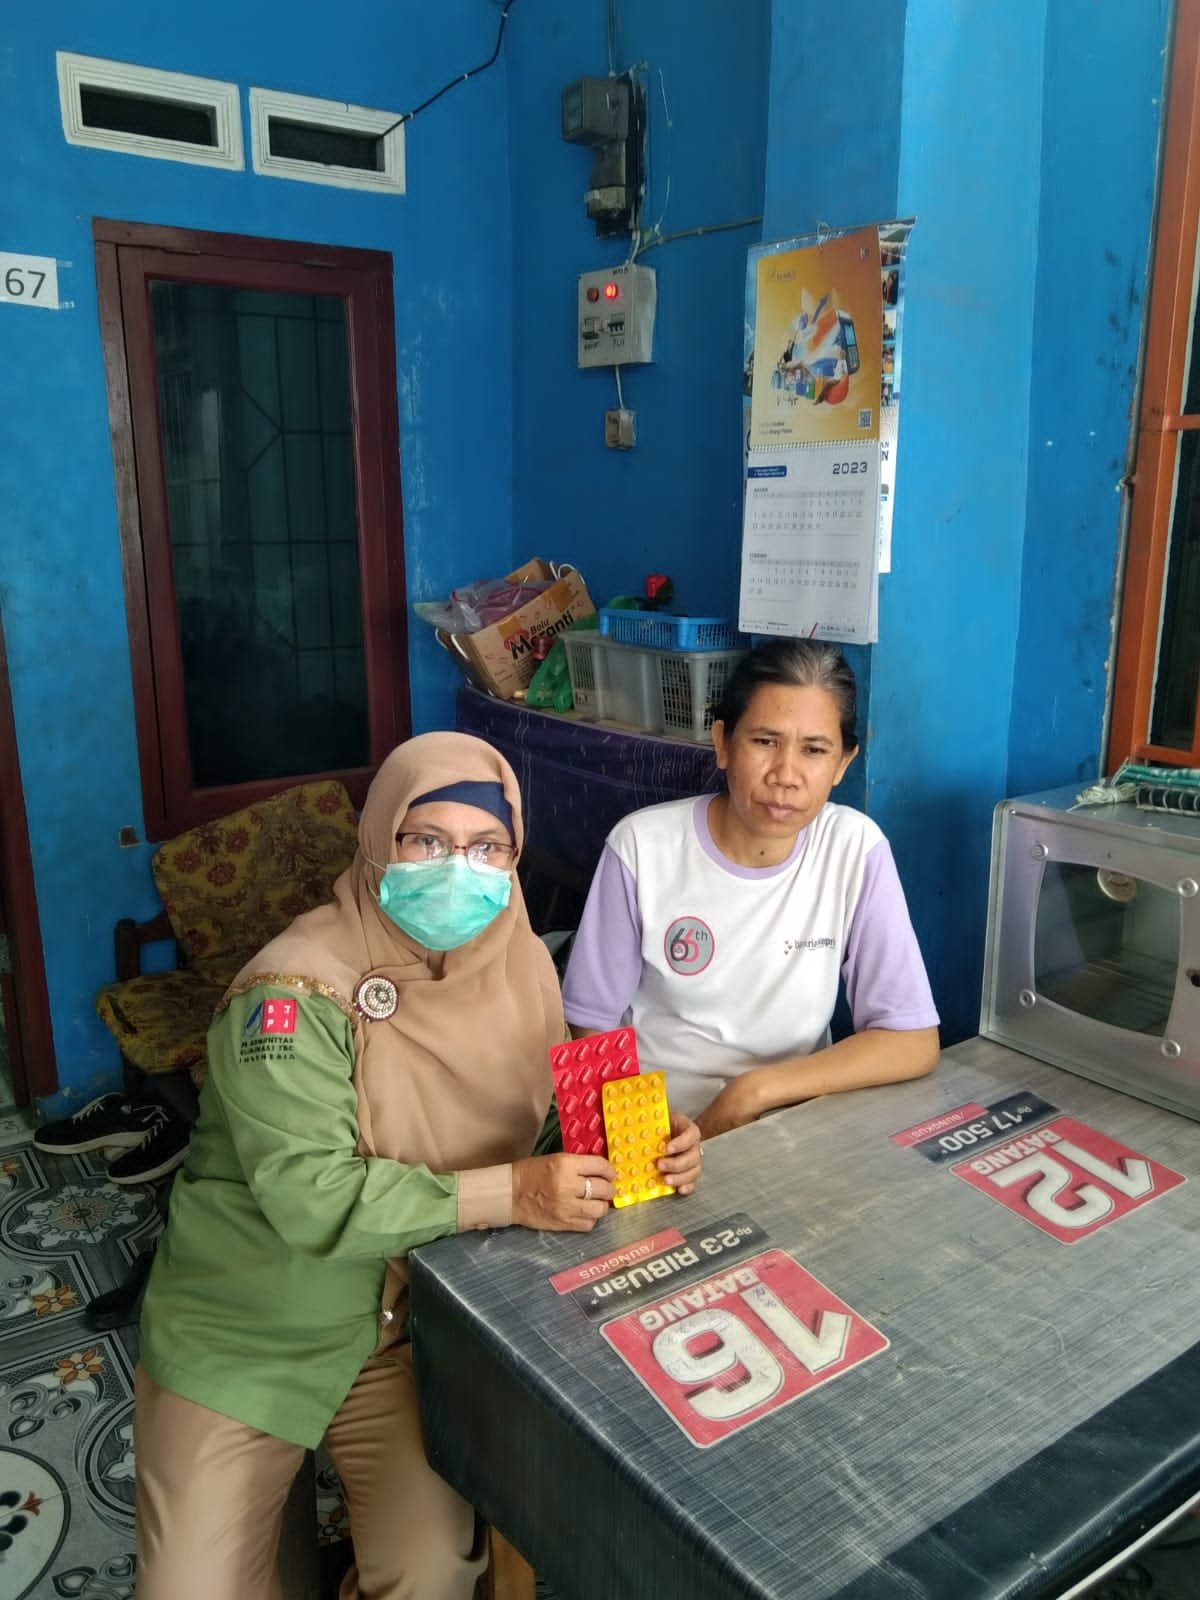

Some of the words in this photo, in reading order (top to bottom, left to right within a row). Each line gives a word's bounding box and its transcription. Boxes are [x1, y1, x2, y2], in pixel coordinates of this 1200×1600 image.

[5, 267, 47, 299] 67
[832, 462, 868, 475] 2023
[530, 619, 550, 635] Bolu
[970, 1129, 1062, 1175] BATANG
[987, 1140, 1155, 1228] 12
[639, 1267, 760, 1331] BATANG
[653, 1308, 852, 1421] 16
